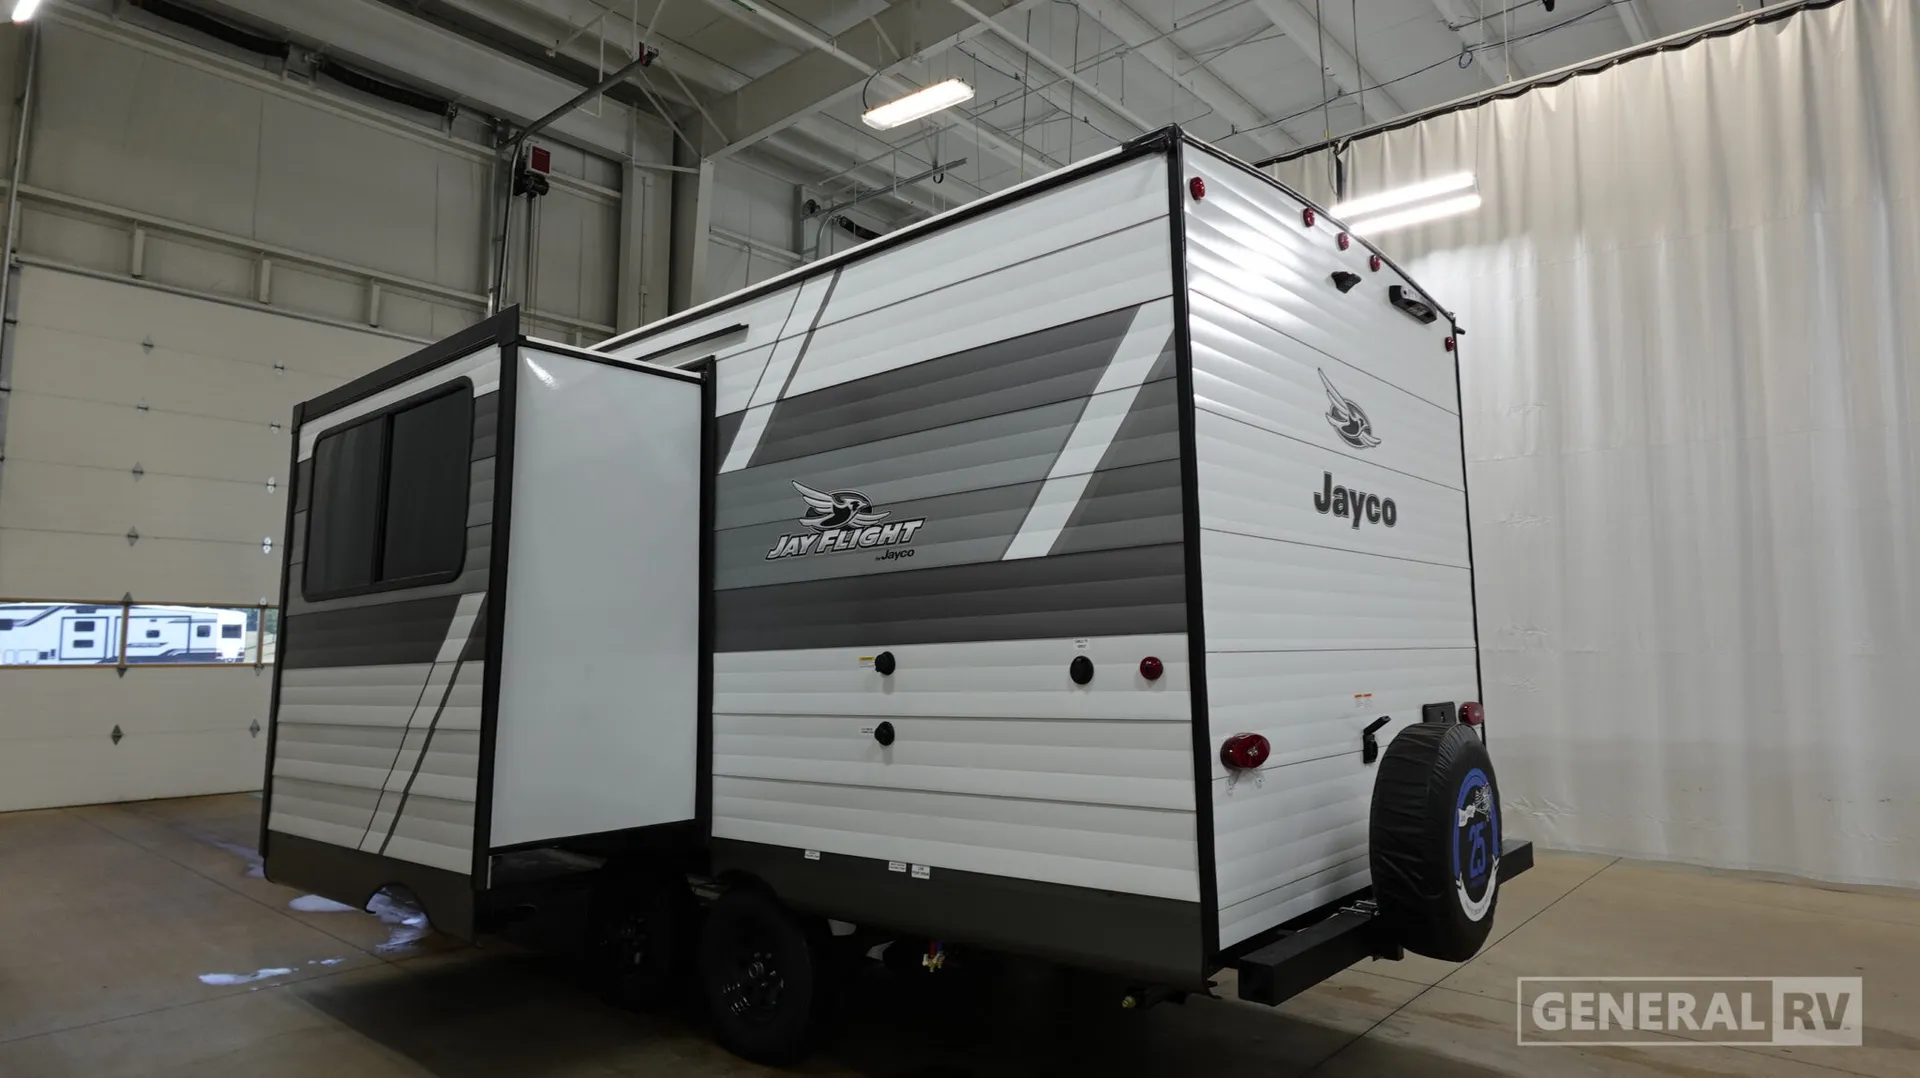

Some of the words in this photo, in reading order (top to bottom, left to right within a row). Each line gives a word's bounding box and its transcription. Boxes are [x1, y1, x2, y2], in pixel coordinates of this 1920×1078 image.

[1313, 471, 1397, 530] Jayco
[766, 533, 818, 560] JAY
[815, 517, 926, 554] FLIGHT
[881, 549, 915, 561] Jayco
[1469, 822, 1486, 878] 25
